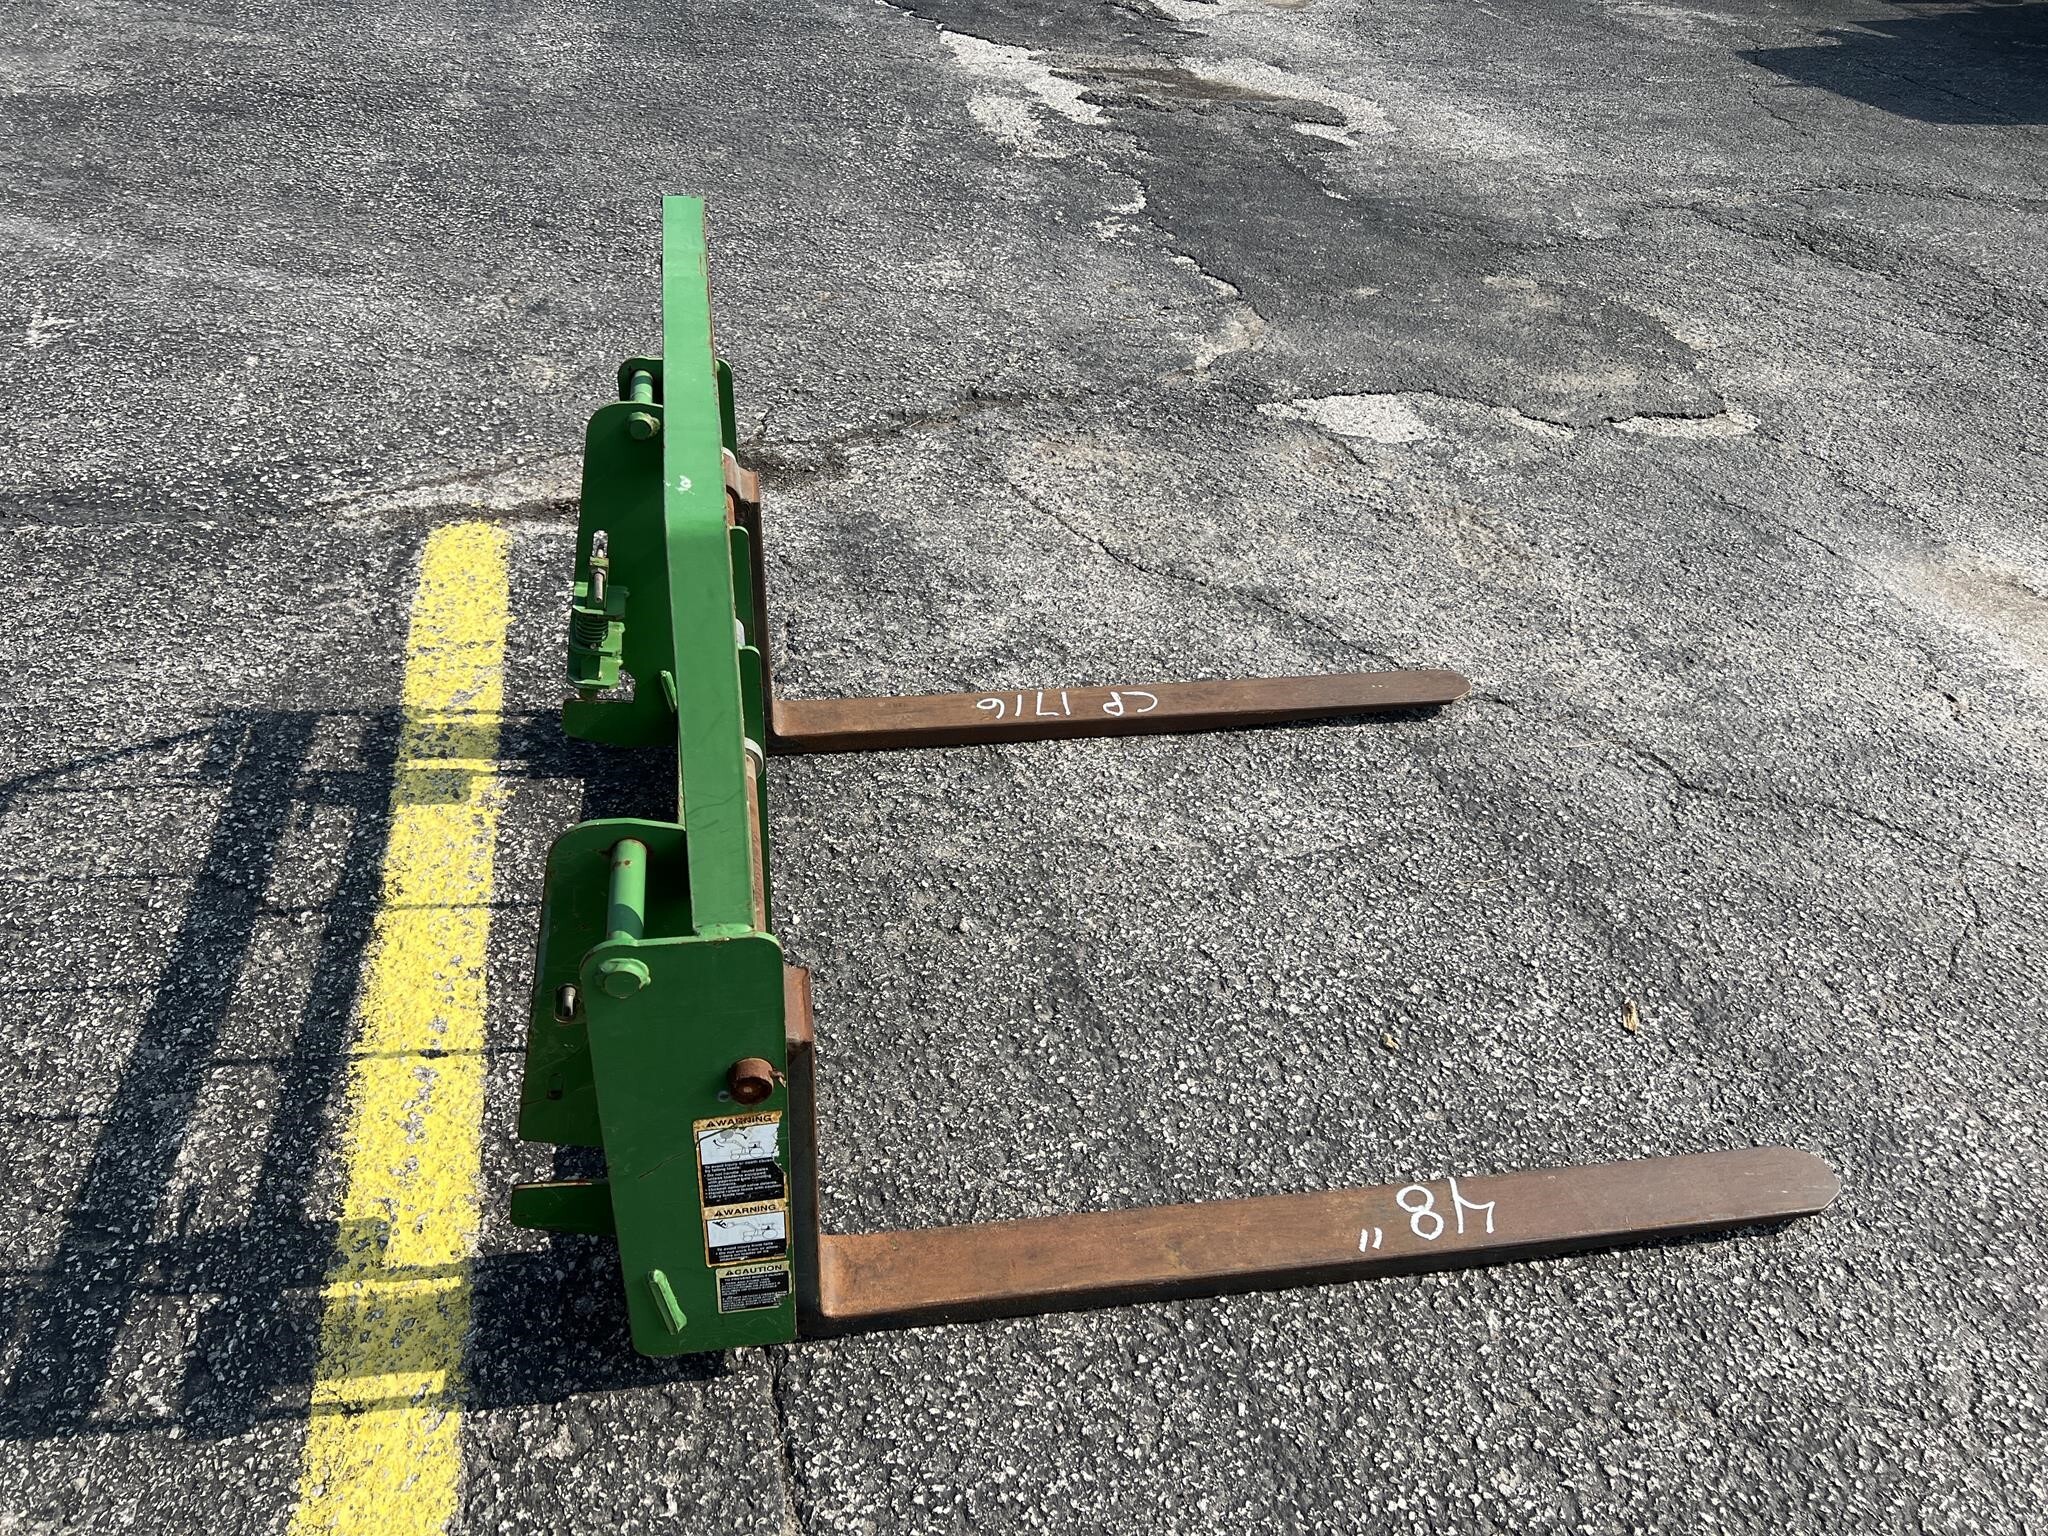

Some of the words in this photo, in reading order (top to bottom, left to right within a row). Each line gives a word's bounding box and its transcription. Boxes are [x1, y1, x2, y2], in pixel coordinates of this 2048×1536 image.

[976, 691, 1071, 719] 1716
[716, 1115, 772, 1126] WARNING
[724, 1204, 776, 1215] WARNING
[734, 1264, 782, 1275] CAUTION
